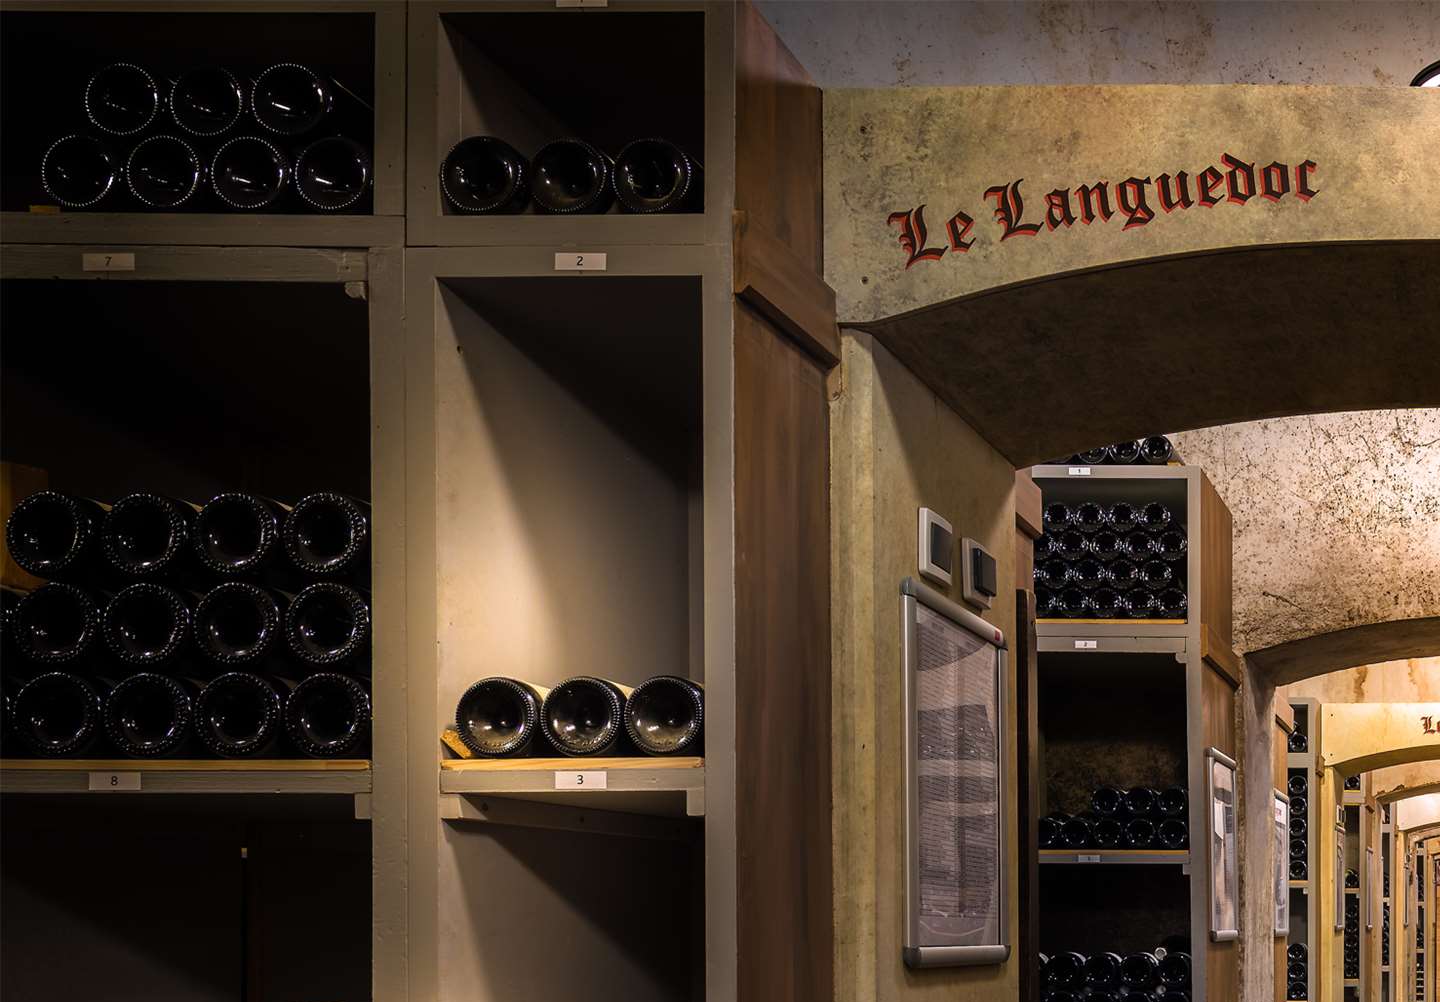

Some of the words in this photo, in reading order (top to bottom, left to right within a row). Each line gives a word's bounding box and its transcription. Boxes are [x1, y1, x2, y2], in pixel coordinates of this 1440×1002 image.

[886, 204, 976, 269] Le
[983, 153, 1320, 241] Languedoc
[577, 256, 583, 266] 2
[111, 776, 118, 786] 8
[577, 775, 583, 785] 3
